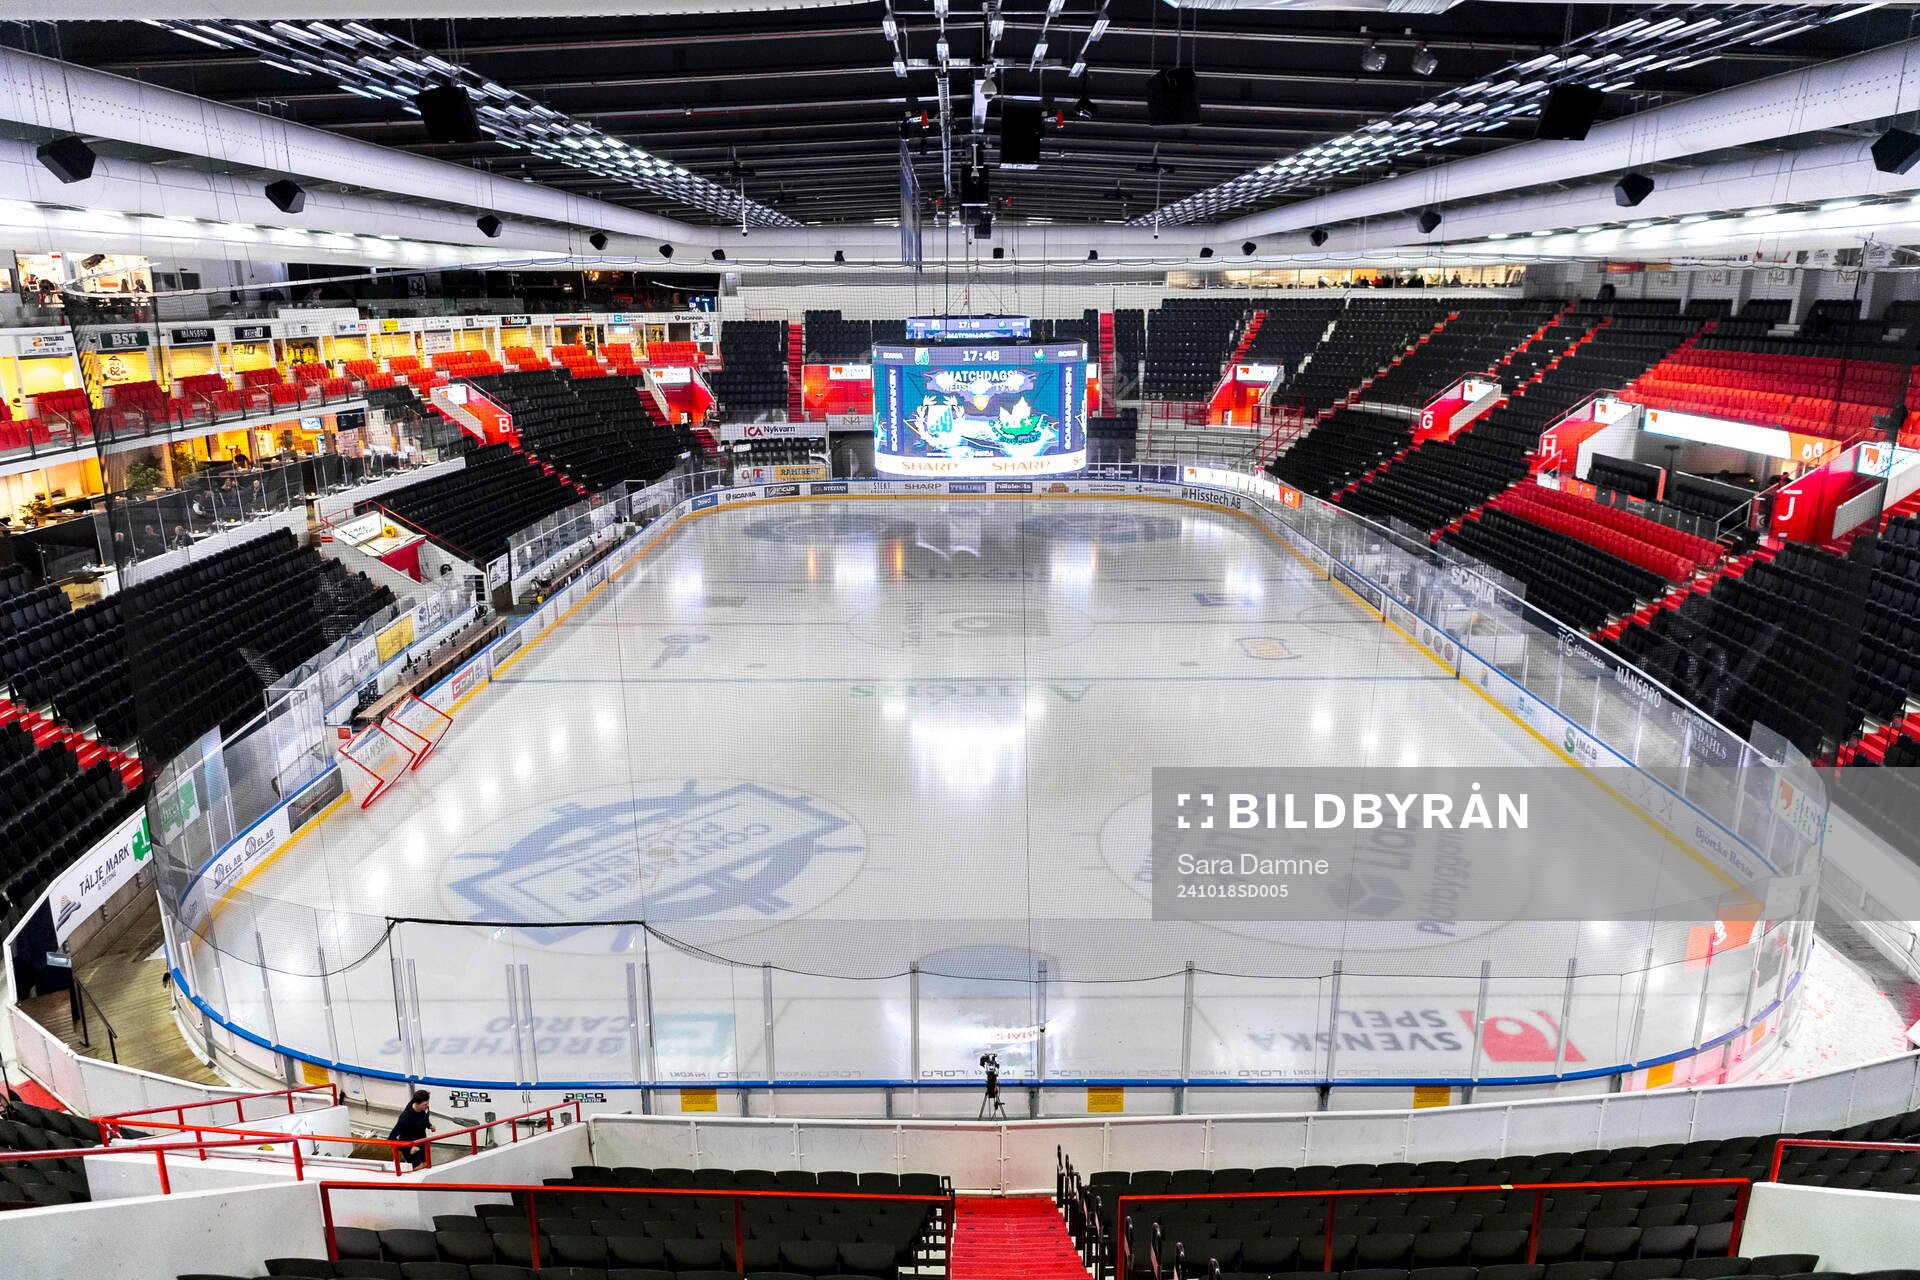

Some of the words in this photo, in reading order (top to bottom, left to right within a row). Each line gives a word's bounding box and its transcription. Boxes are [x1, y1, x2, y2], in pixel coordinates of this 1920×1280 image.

[111, 333, 138, 346] BST
[963, 351, 1000, 361] 17:48
[499, 418, 510, 433] B
[1422, 414, 1434, 430] G
[744, 426, 763, 437] ICA
[764, 425, 796, 434] Nykvarn
[1542, 438, 1556, 457] H
[902, 461, 958, 472] SHARP
[992, 461, 1051, 472] SHARP
[1189, 488, 1229, 507] Hisstech
[1230, 497, 1242, 510] AB
[1777, 497, 1795, 521] J
[1615, 666, 1662, 708] MÅNSBRO
[79, 866, 104, 896] TÄLJE
[106, 843, 130, 875] MARK
[1336, 1010, 1448, 1029] SPEL
[1247, 1032, 1463, 1051] SVENSKA
